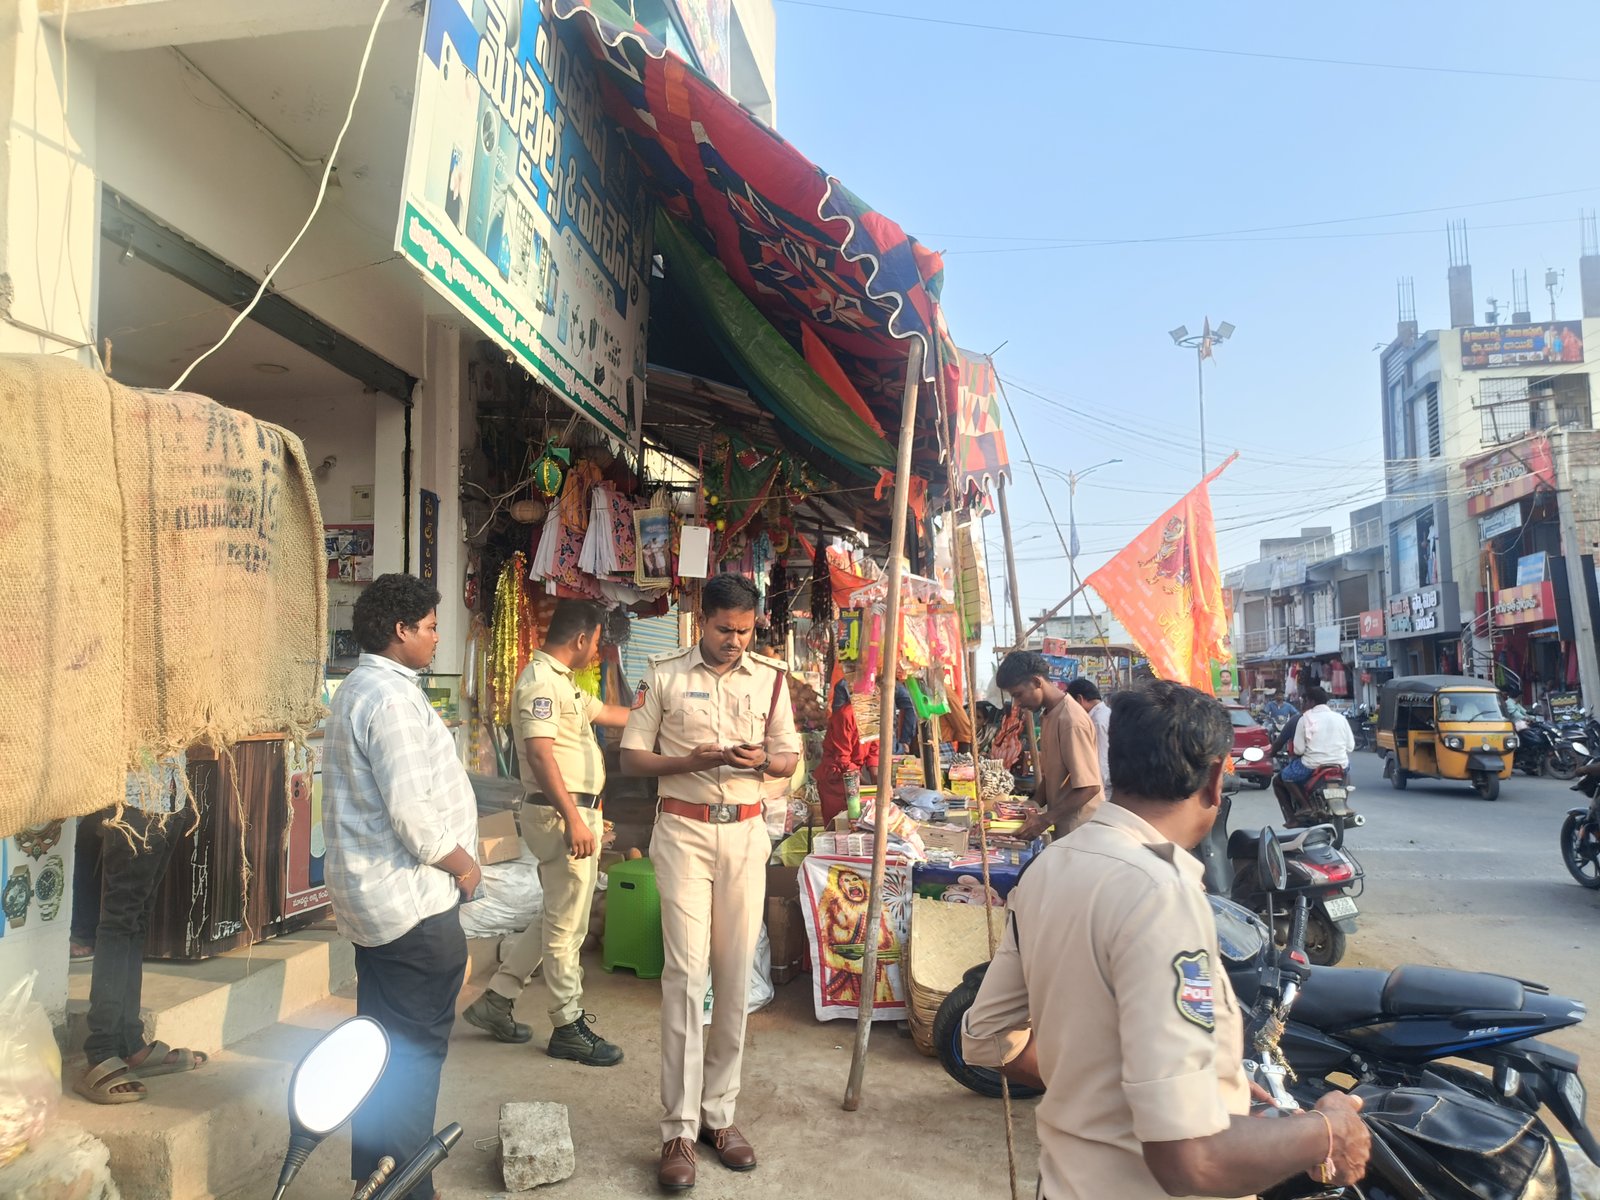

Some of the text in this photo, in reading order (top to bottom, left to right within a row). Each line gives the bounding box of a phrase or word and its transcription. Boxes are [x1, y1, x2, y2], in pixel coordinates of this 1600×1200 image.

[564, 157, 577, 221] &
[579, 177, 630, 290] వాచెస్
[1183, 986, 1212, 1000] POLI
[1468, 1026, 1499, 1036] 150
